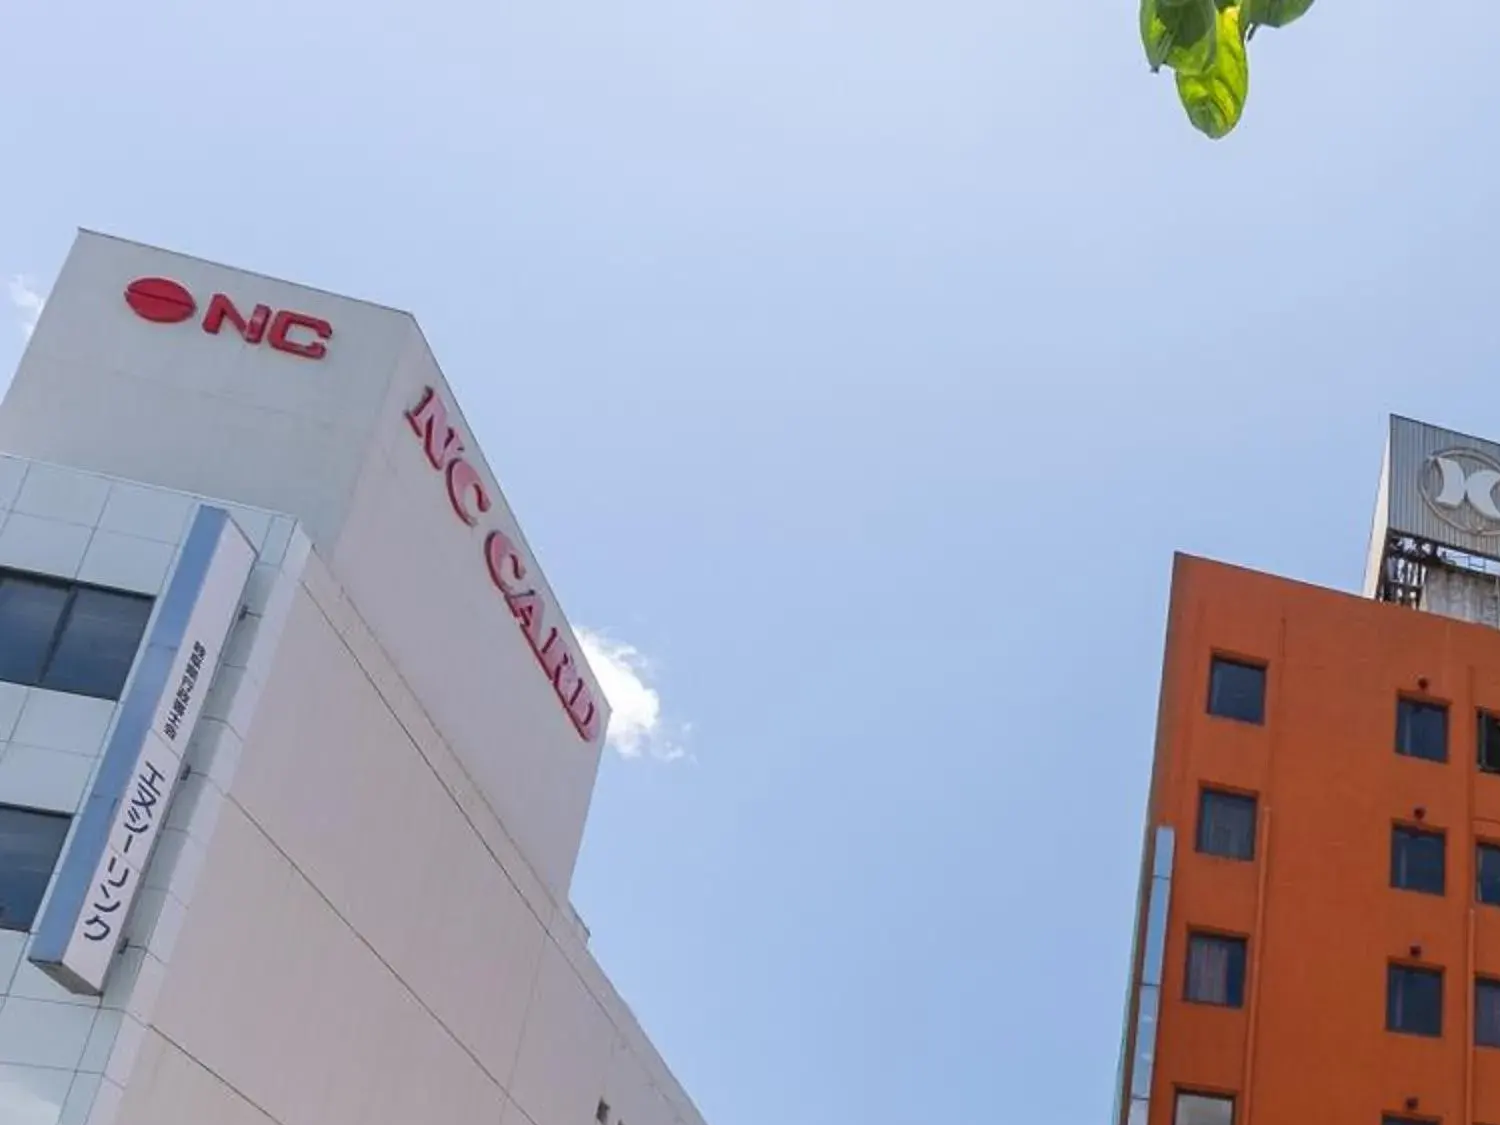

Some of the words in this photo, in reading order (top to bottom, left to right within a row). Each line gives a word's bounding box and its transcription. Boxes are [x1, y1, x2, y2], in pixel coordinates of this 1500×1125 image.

[202, 292, 333, 359] NC
[403, 386, 492, 526] NC
[484, 530, 601, 742] CARD
[83, 761, 167, 941] エヌシーリンク
